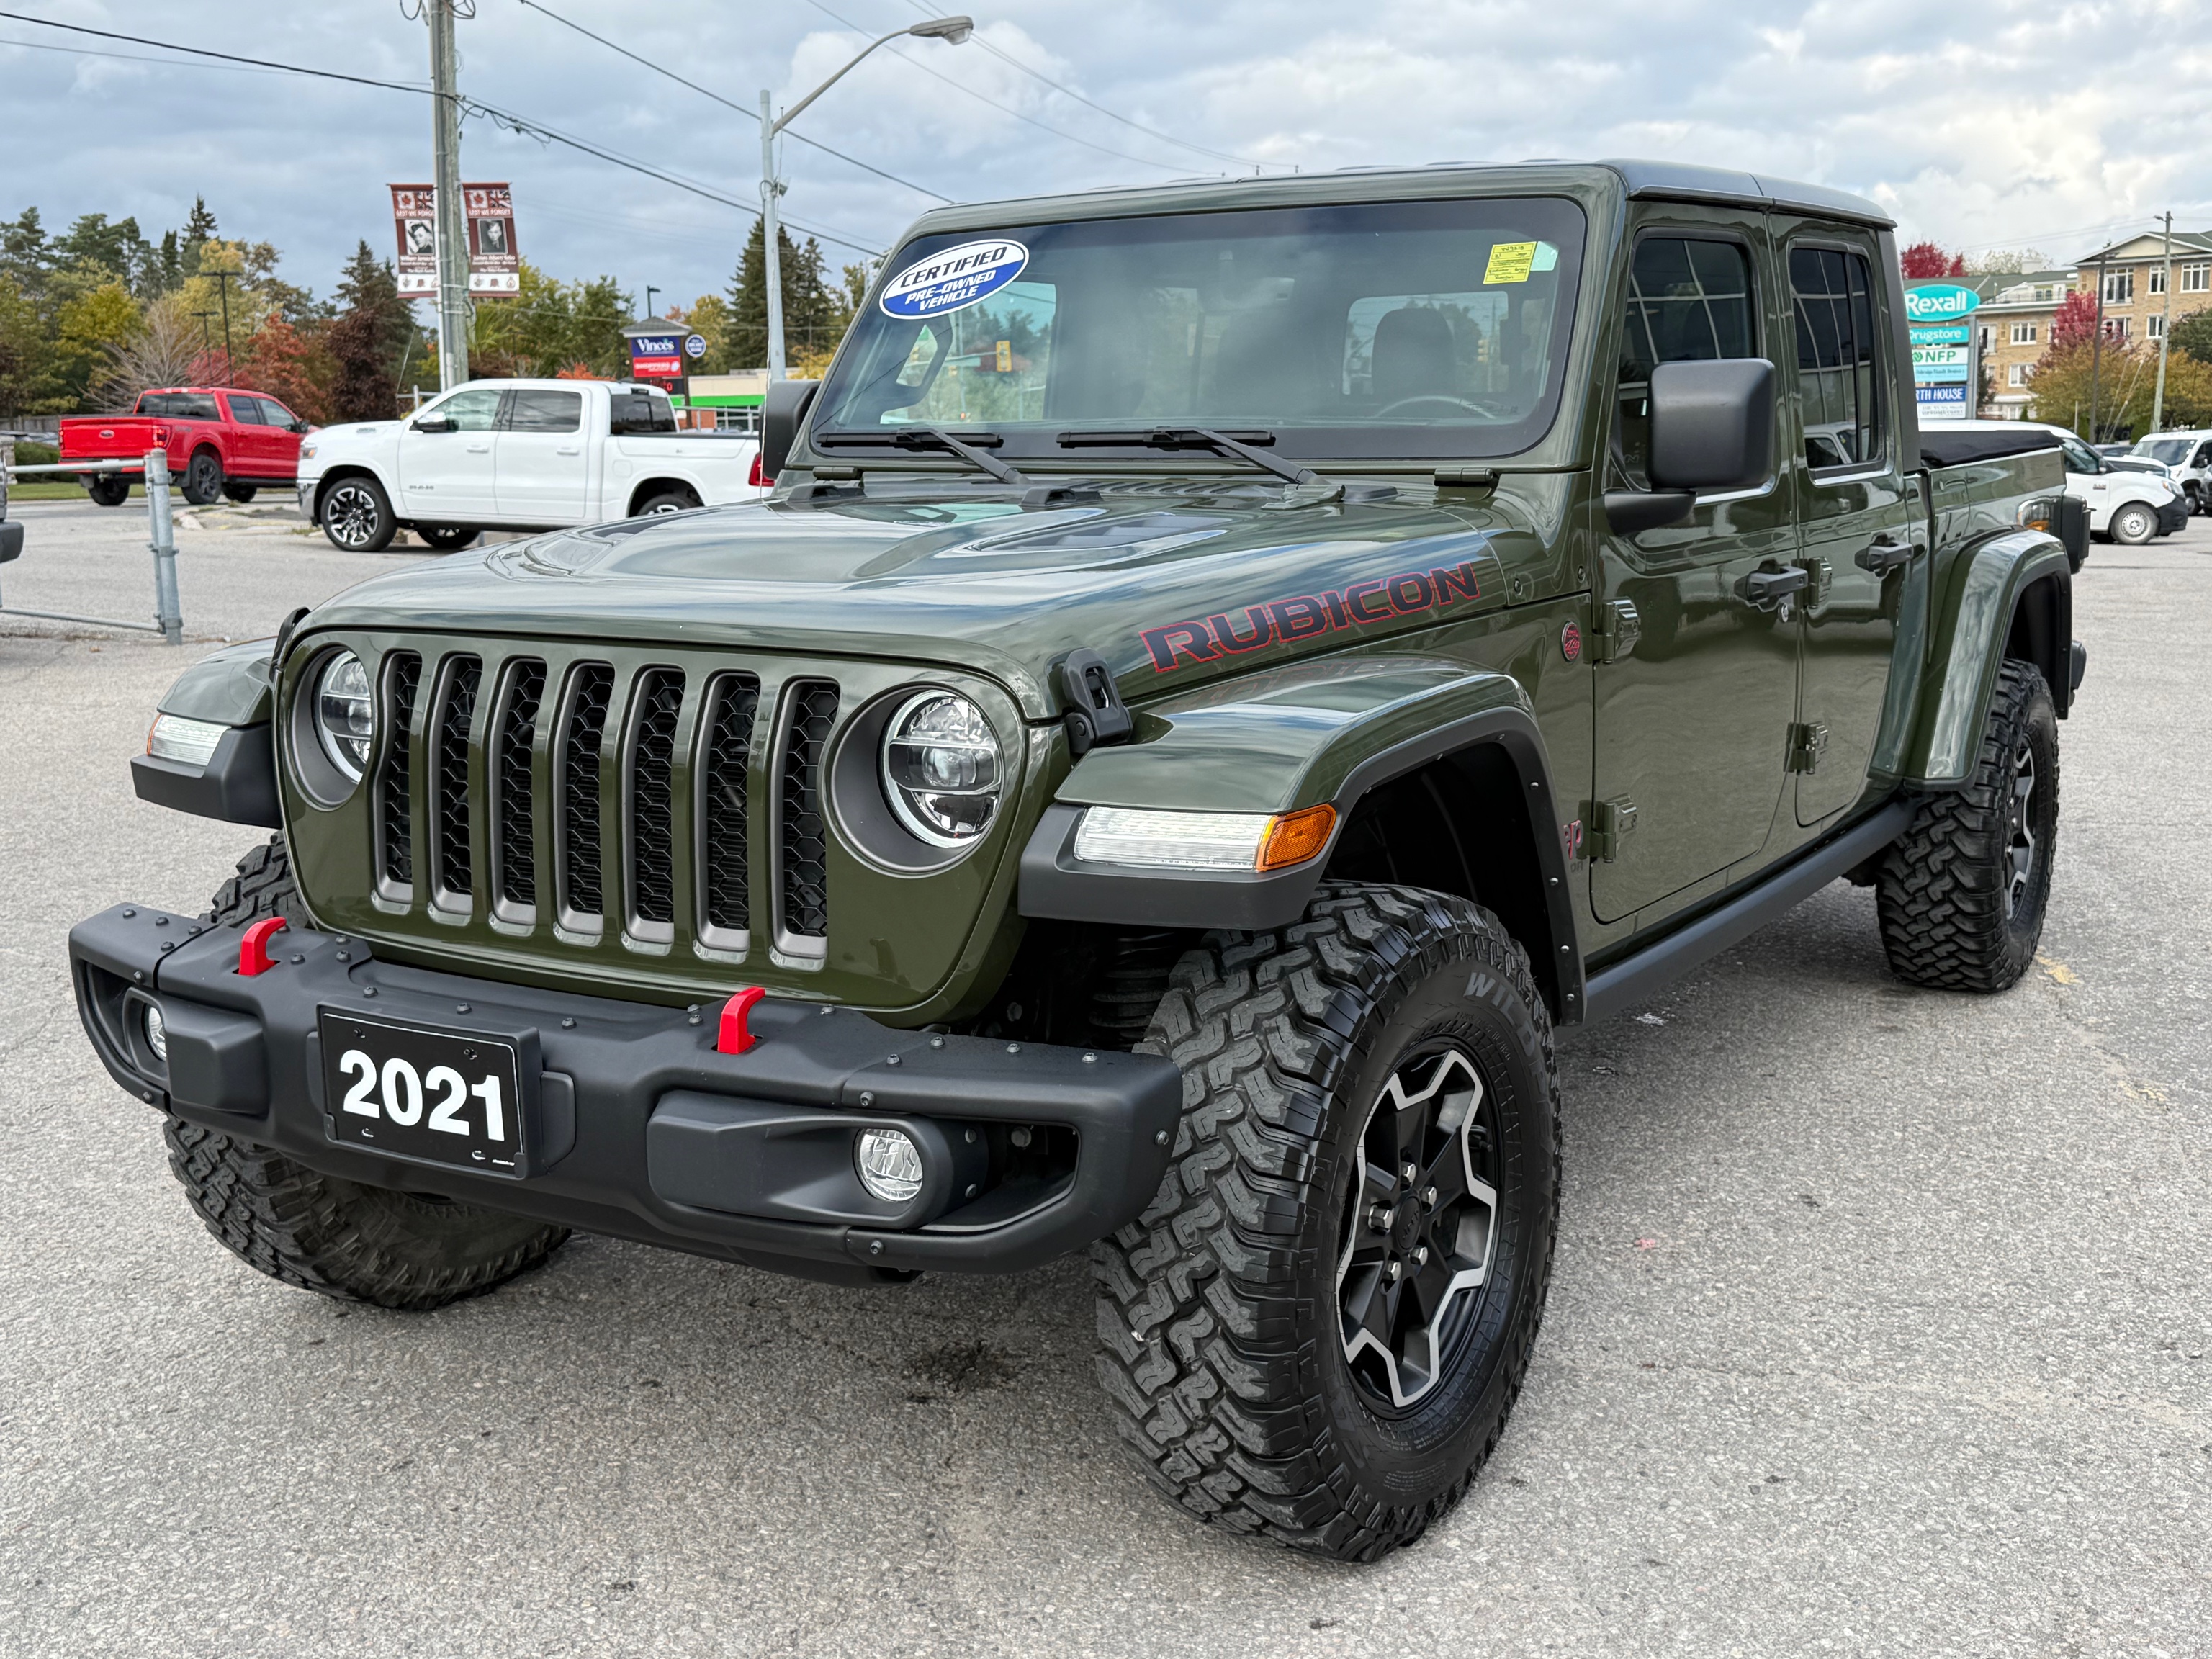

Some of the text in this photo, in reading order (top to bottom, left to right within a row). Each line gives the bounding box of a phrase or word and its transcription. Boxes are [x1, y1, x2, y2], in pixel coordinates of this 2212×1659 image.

[900, 246, 1007, 288] CERTIFIED
[905, 270, 997, 305] PRE-OWNED
[920, 285, 979, 311] VEHICLE
[1905, 291, 1967, 316] Rexall
[1925, 351, 1956, 362] NFP
[1933, 388, 1964, 400] HOUSE
[1138, 561, 1481, 673] RUBICON
[339, 1048, 505, 1142] 2021
